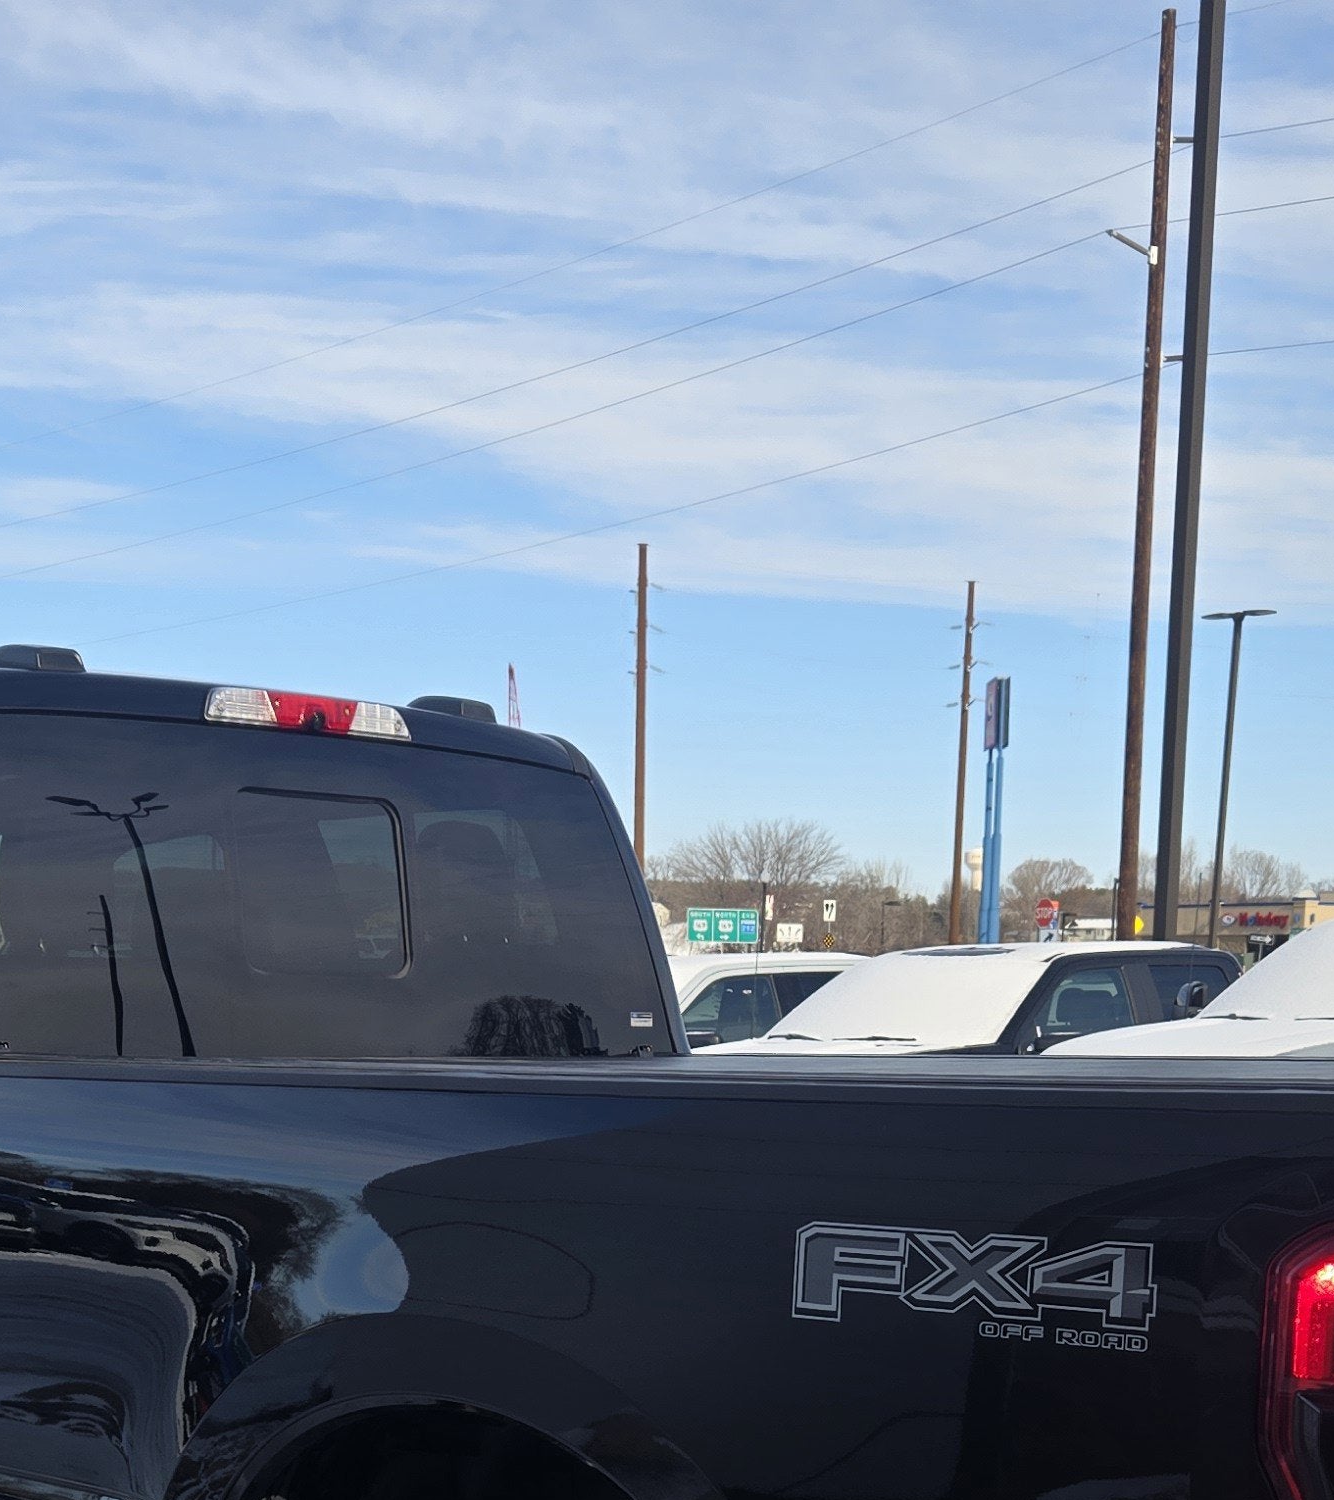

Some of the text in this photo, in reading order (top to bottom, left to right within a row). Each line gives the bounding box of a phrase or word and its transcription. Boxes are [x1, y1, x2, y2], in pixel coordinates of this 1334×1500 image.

[1036, 908, 1053, 918] STOP
[1238, 912, 1289, 928] Holiday
[792, 1221, 1157, 1331] FX4
[978, 1321, 1149, 1352] OFF ROAD
